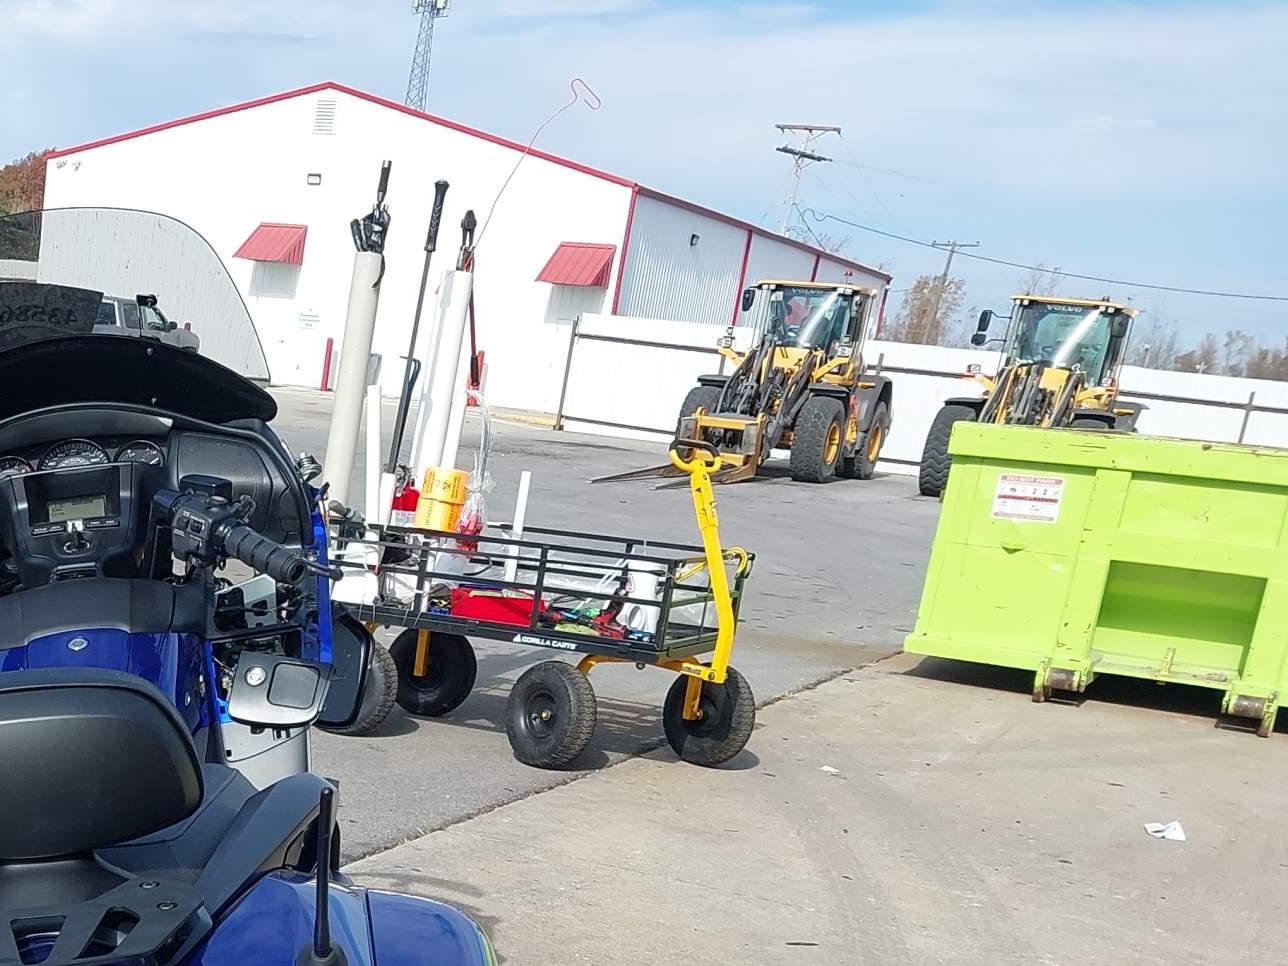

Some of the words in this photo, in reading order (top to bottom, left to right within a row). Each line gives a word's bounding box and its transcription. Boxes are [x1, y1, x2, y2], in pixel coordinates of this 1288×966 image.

[791, 287, 824, 295] VOLVO
[1046, 304, 1083, 313] VOLVO
[522, 636, 551, 647] GORILLA
[552, 640, 576, 650] CARTS
